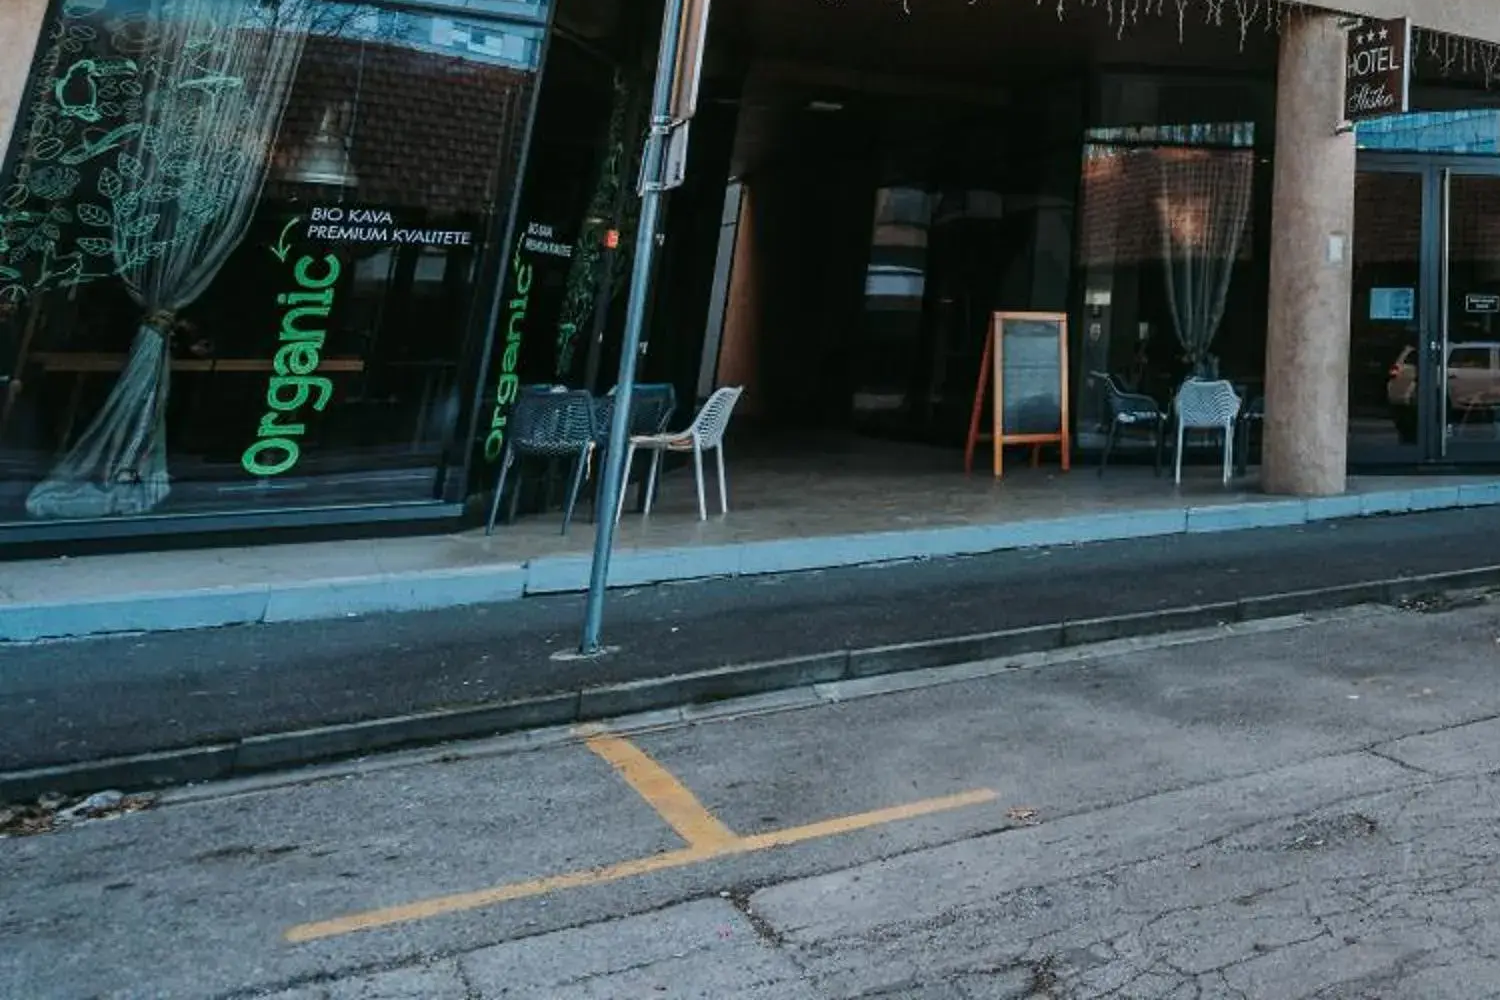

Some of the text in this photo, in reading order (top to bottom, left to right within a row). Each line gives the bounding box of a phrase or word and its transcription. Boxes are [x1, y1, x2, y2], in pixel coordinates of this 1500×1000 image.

[1347, 46, 1400, 78] HOTEL
[311, 207, 393, 224] BIO KAVA
[307, 225, 472, 245] PREMIUM KVALITETE
